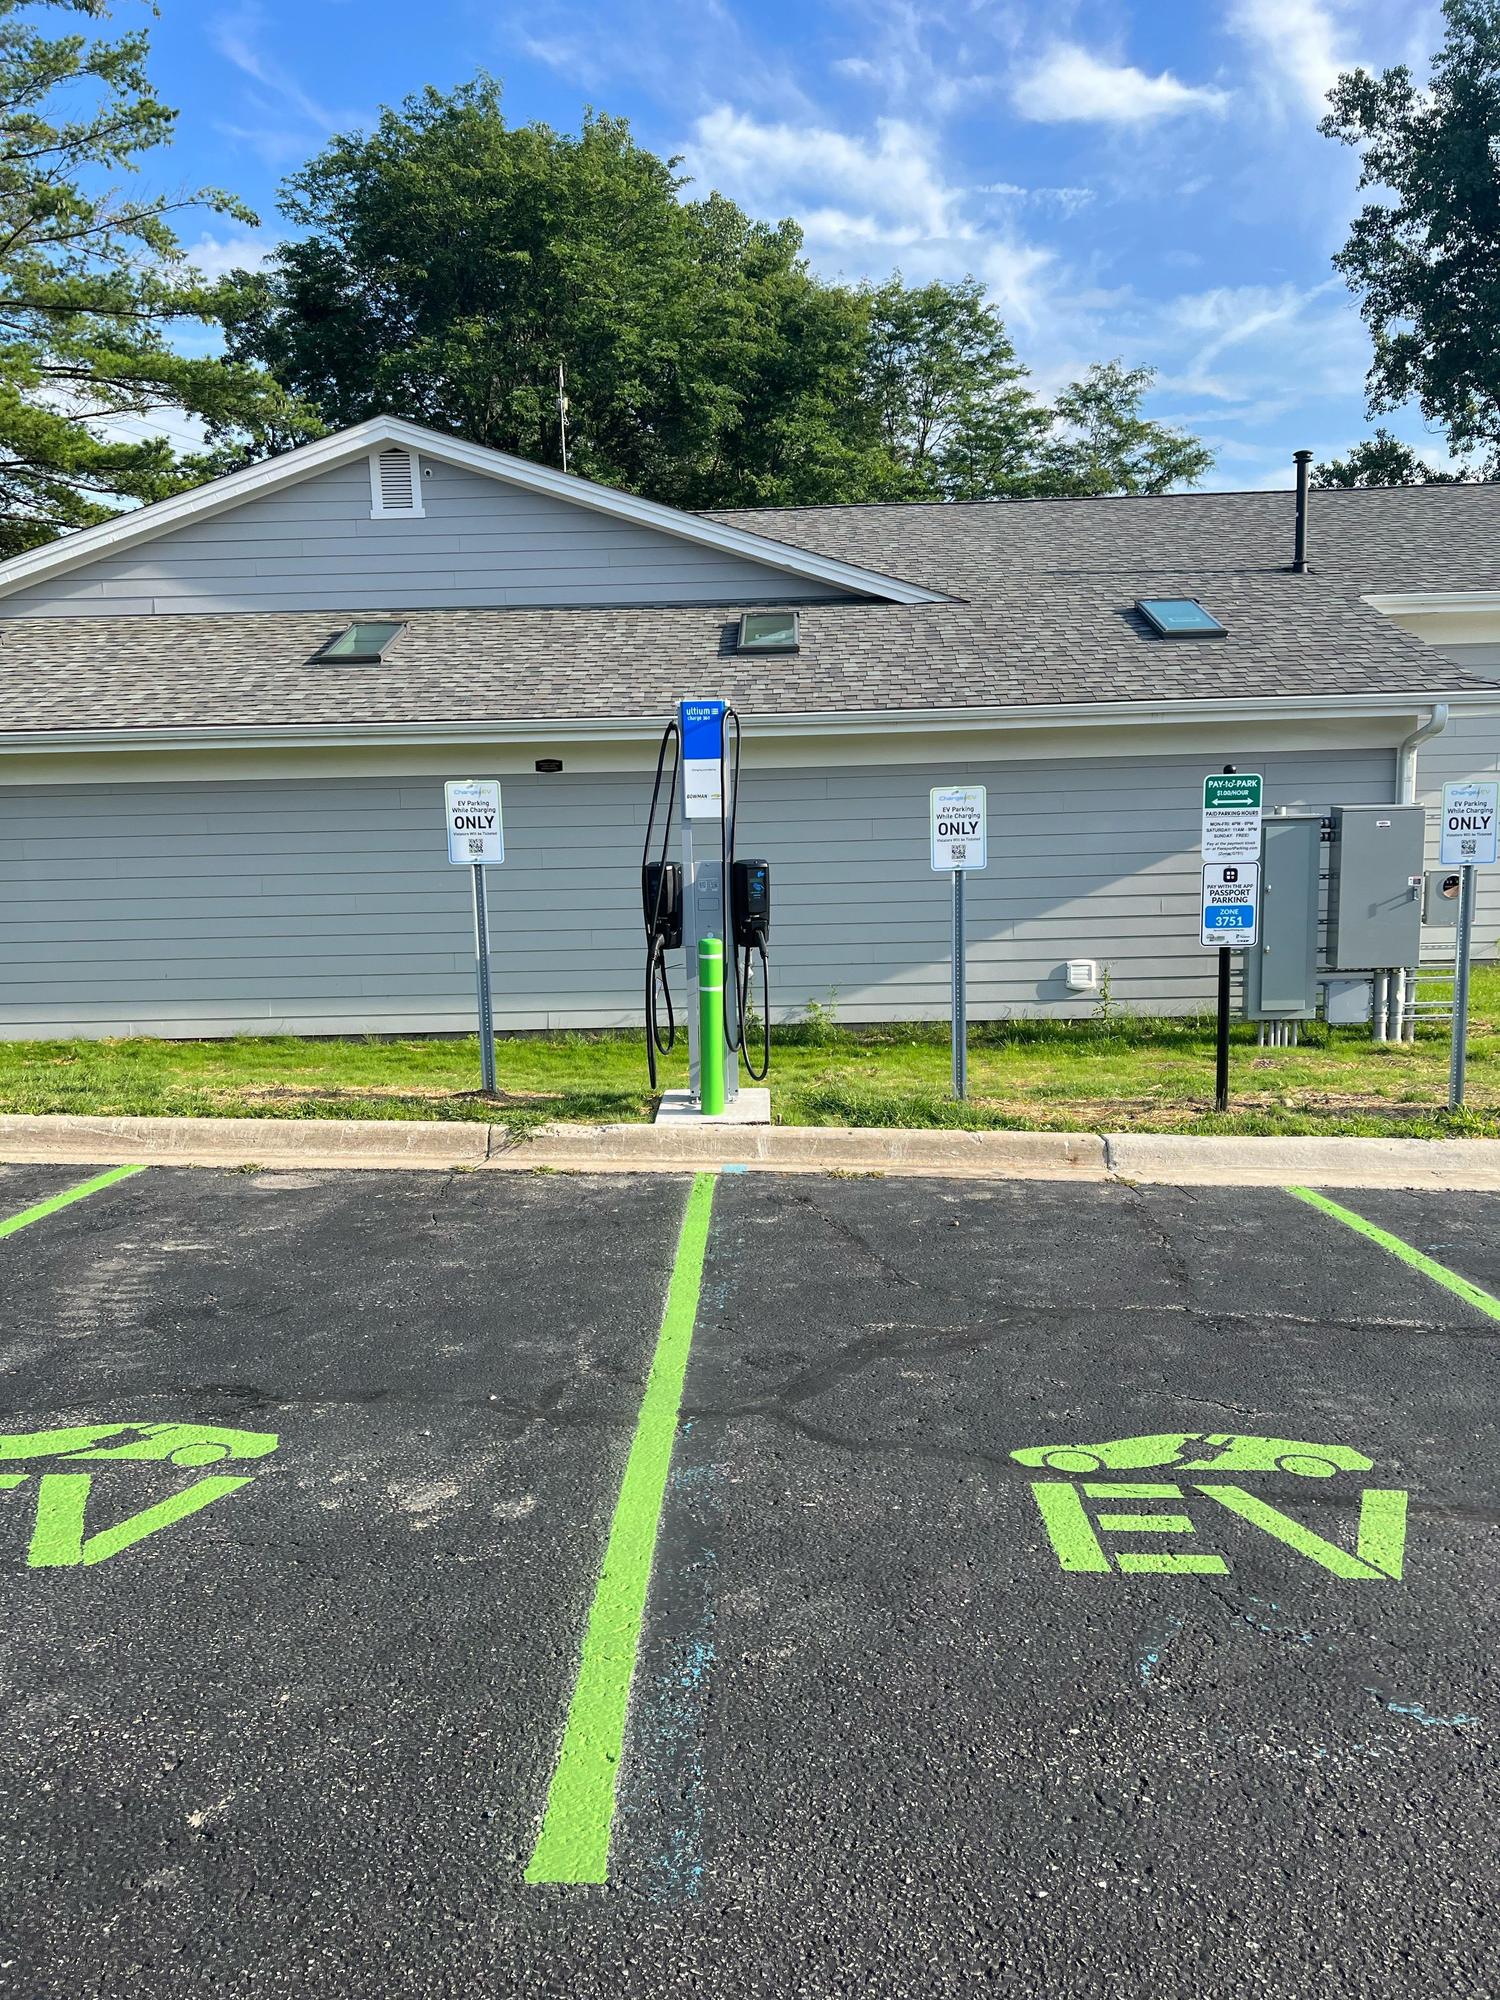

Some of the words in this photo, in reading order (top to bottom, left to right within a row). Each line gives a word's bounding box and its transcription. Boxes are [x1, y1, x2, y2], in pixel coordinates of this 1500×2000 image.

[686, 707, 710, 715] ultium
[454, 816, 494, 829] ONLY
[938, 821, 978, 835] ONLY
[1448, 816, 1491, 830] ONLY
[1215, 917, 1243, 926] 3751
[0, 1474, 255, 1567] V
[1030, 1483, 1408, 1580] EV
